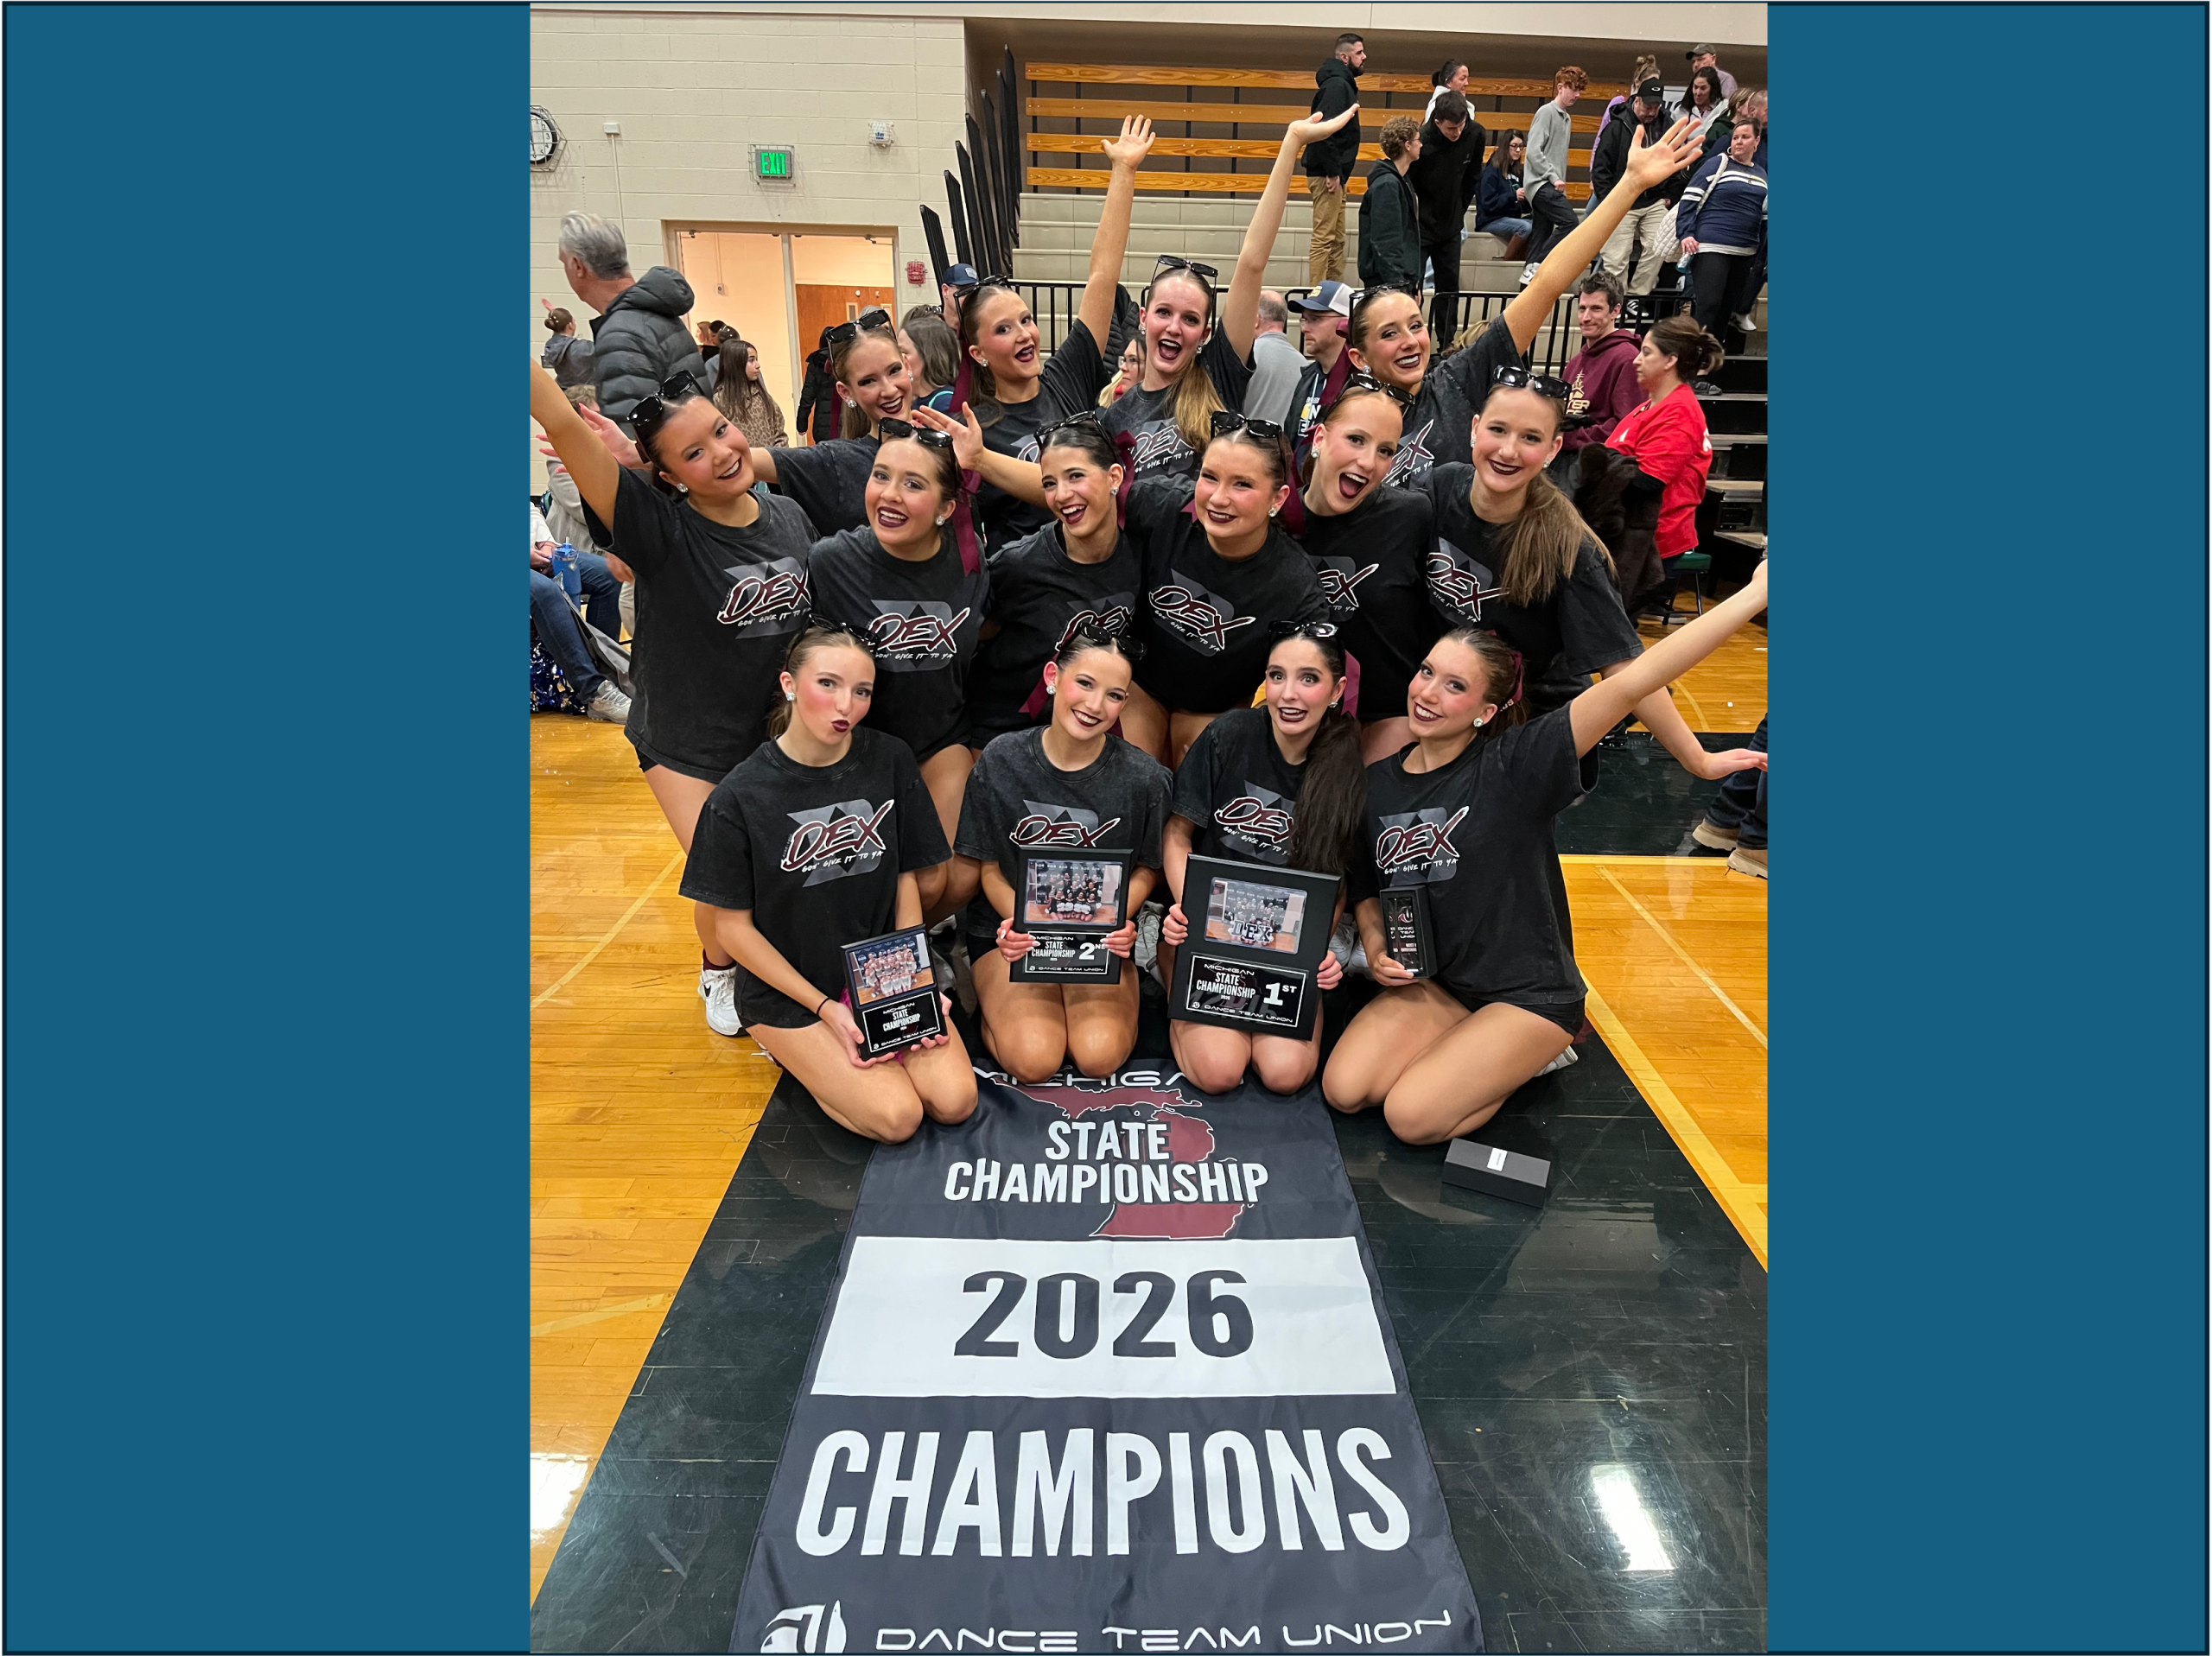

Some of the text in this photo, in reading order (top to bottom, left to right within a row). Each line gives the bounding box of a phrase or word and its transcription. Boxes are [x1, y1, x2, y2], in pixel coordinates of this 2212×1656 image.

[760, 152, 786, 175] EXIT
[1162, 456, 1173, 465] IT
[1381, 418, 1435, 484] EX
[717, 568, 812, 624] DEX
[1317, 563, 1380, 607] EX
[1426, 552, 1510, 621] DEX
[759, 614, 778, 623] GIVE
[779, 612, 792, 620] IT
[1149, 586, 1256, 650] DEX
[1170, 621, 1185, 633] GIVE
[868, 606, 971, 653] DEX
[780, 798, 895, 872] DEX
[1009, 814, 1121, 847] DEX
[1241, 834, 1259, 844] GIVE
[1376, 805, 1470, 870] DEX
[823, 858, 842, 867] GIVE
[844, 854, 857, 864] IT
[871, 851, 884, 860] YA
[1402, 864, 1419, 872] GIVE
[1421, 862, 1432, 871] IT
[1446, 858, 1459, 866] YA
[1230, 920, 1271, 942] DEX
[1031, 949, 1076, 958] CHAMPIONSHIP
[1045, 941, 1064, 949] STATE
[1204, 963, 1255, 976] MICHIGAN
[1215, 972, 1240, 986] STATE
[1196, 979, 1256, 999] CHAMPIONSHIP
[882, 1013, 921, 1031] CHAMPIONSHIP
[892, 1008, 909, 1020] STATE
[1204, 1005, 1236, 1013] DANCE
[1238, 1010, 1263, 1018] TEAM
[972, 1066, 1244, 1087] MIHIGA
[1045, 1120, 1171, 1161] STATE
[944, 1157, 1269, 1204] CHAMPIONSHIP
[954, 1270, 1254, 1359] 2026
[796, 1427, 1410, 1557] CHAMPIONS
[876, 1609, 1452, 1653] DANCE TEAM UNION
